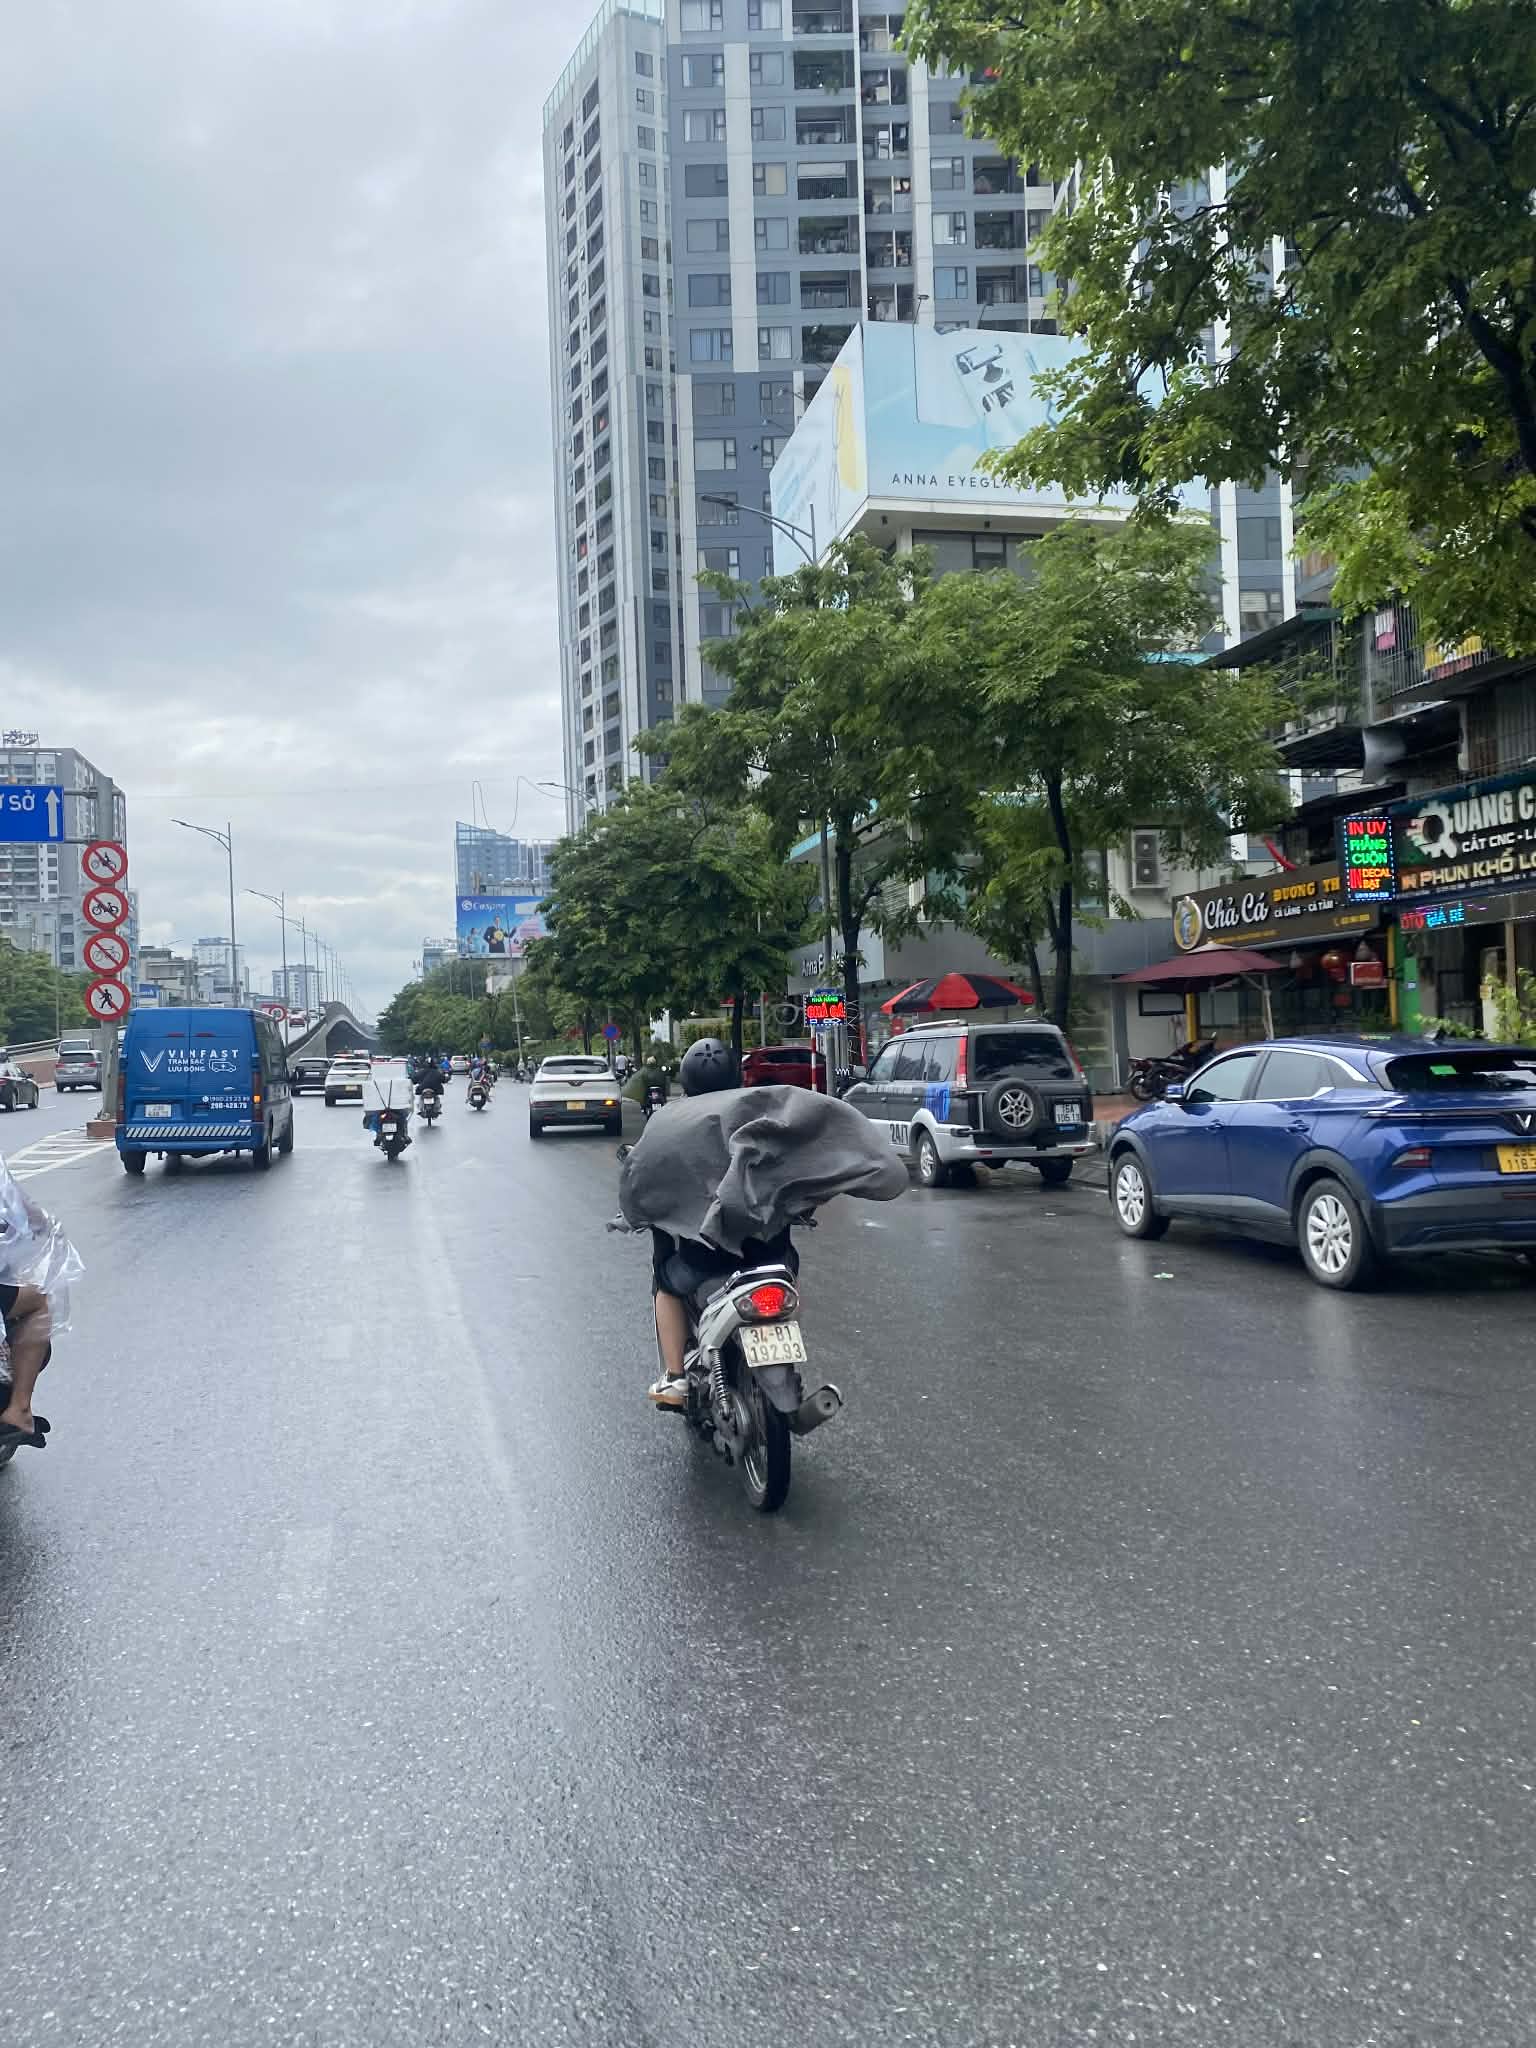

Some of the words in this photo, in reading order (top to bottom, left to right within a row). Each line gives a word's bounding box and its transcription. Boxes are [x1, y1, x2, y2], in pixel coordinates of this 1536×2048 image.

[892, 473, 938, 486] ANNA
[9, 789, 36, 812] SỞ
[1348, 821, 1364, 835] IN
[1366, 821, 1387, 835] UV
[1489, 831, 1515, 848] CNC
[1351, 850, 1388, 867] CUỘN
[1350, 868, 1362, 889] IN
[1362, 868, 1391, 878] DECAL
[1419, 865, 1469, 887] PHUN
[1204, 897, 1240, 930] Chả
[1241, 891, 1270, 924] Cá
[168, 1049, 239, 1059] VINFAST
